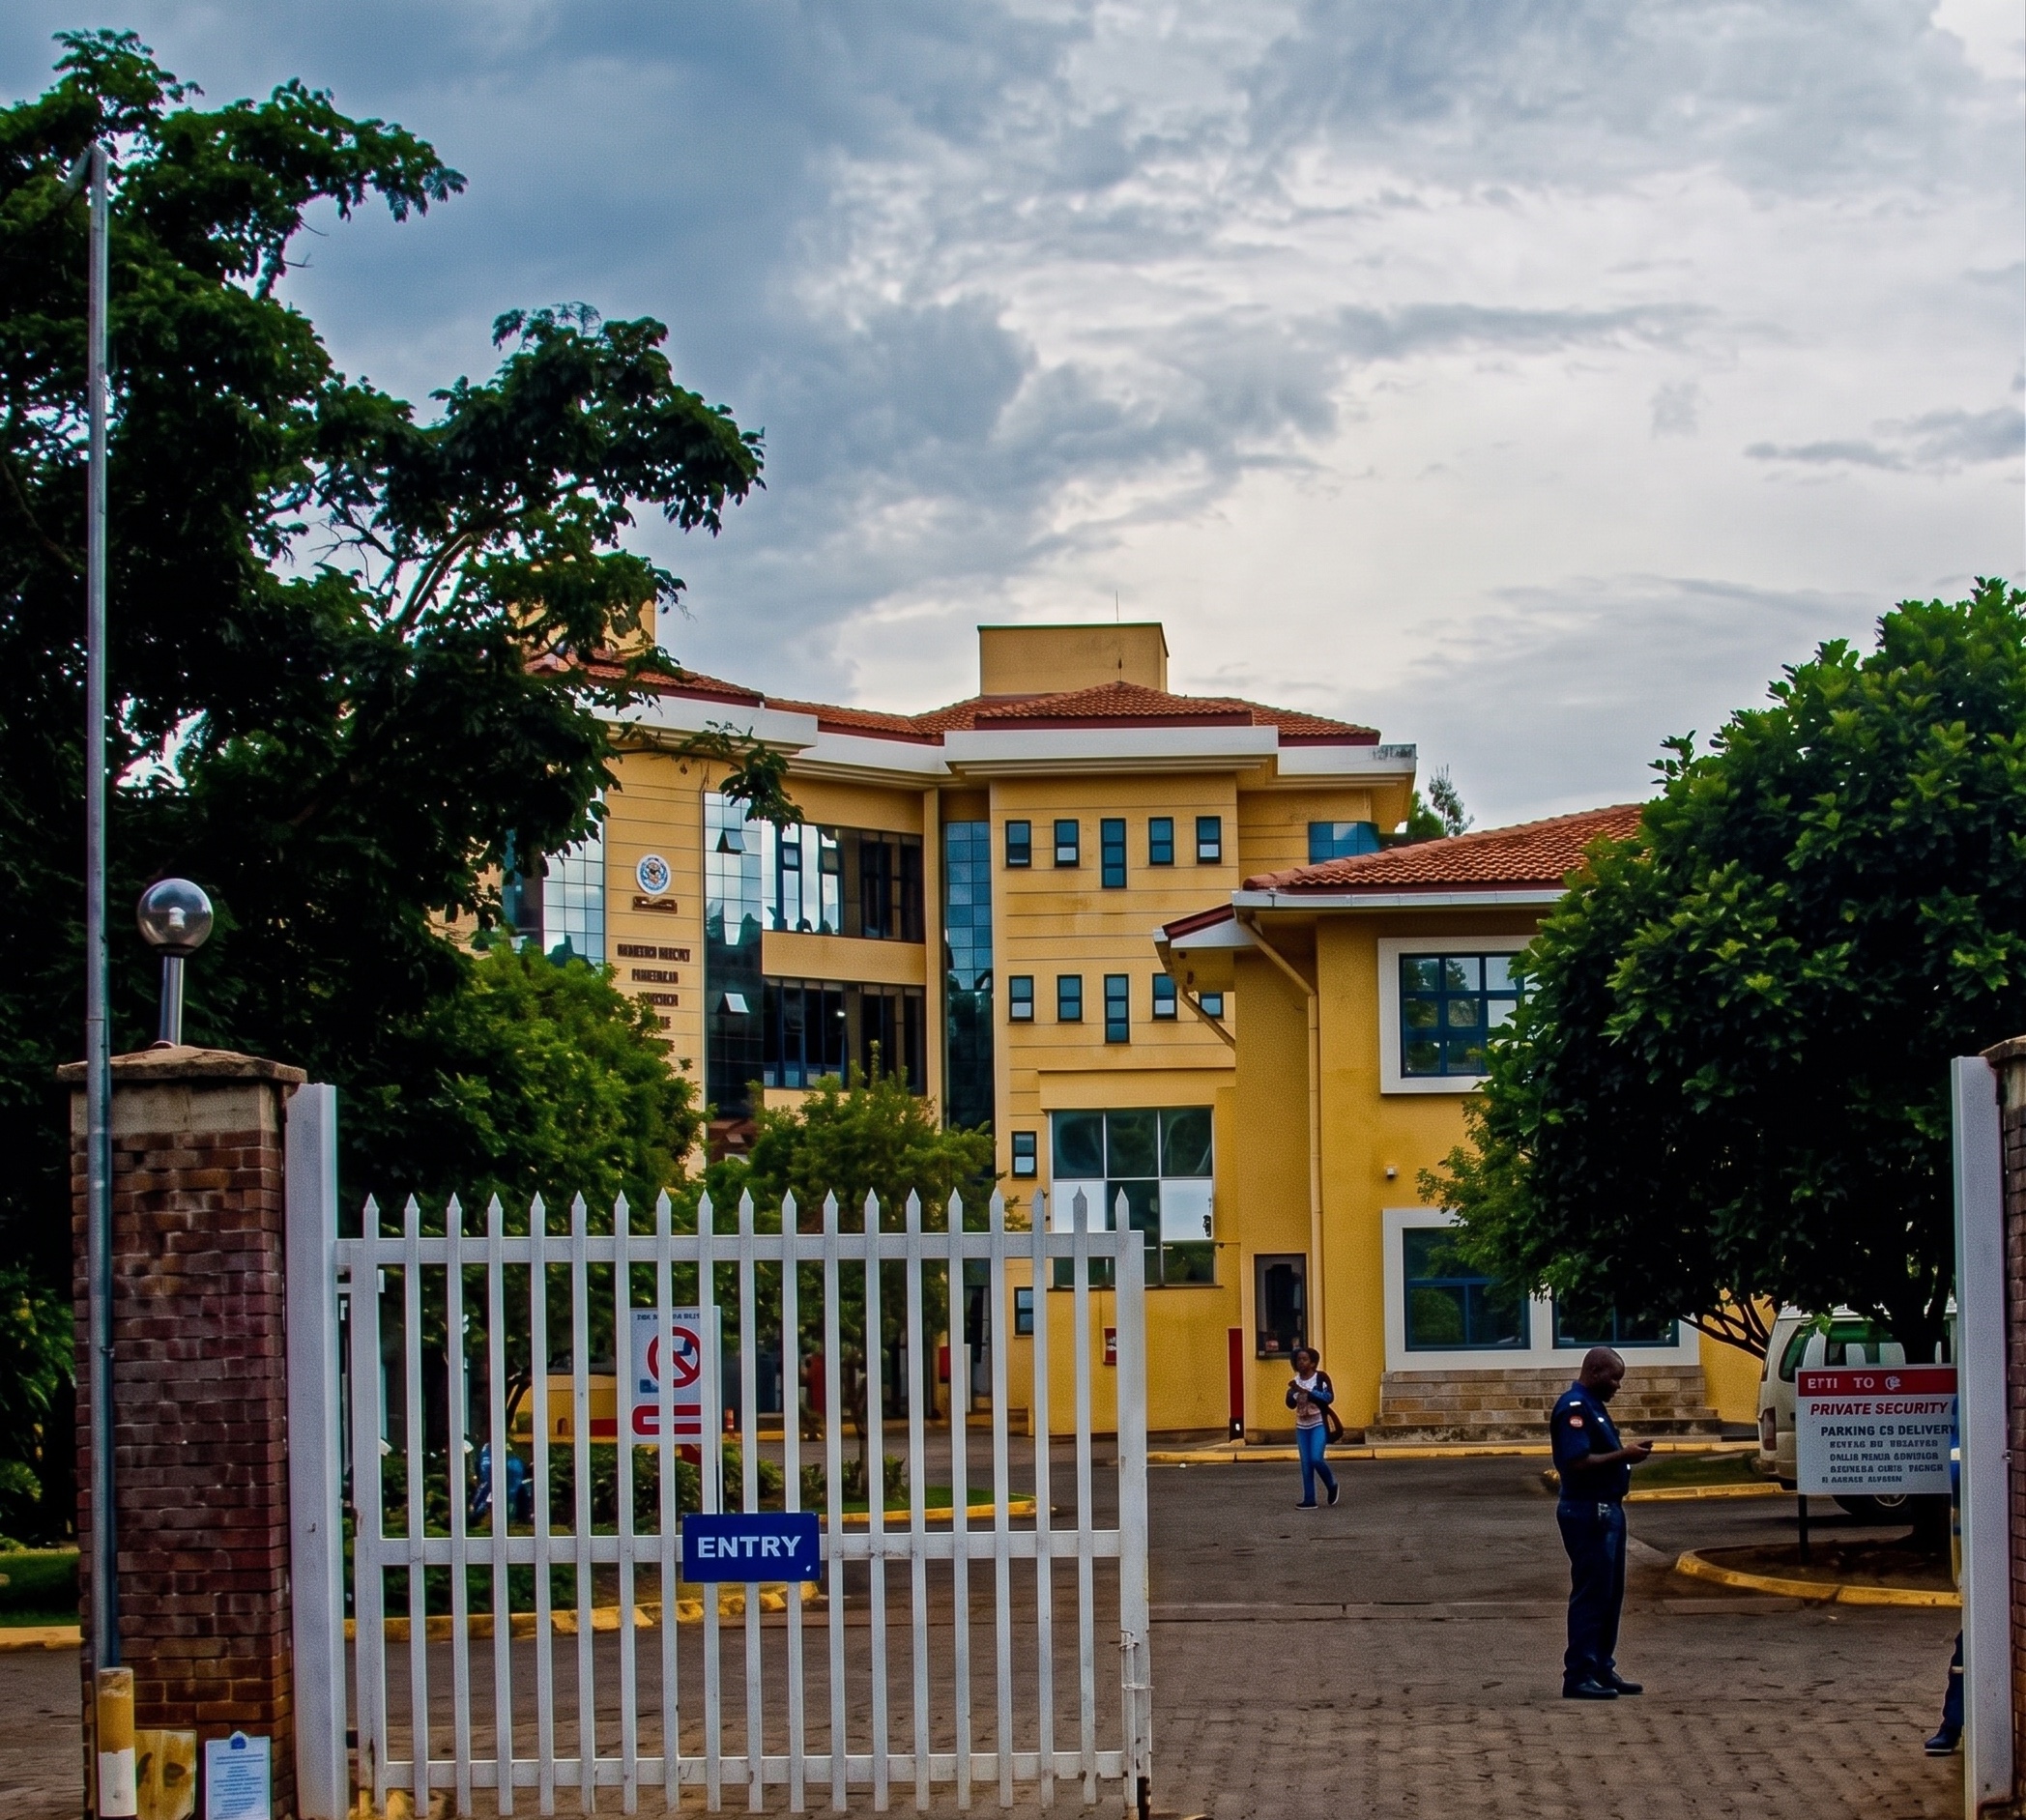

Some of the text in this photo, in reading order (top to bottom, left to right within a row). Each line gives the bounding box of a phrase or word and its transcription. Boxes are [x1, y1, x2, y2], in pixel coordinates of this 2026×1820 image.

[1810, 1401, 1949, 1415] PRIVATE SECURITY
[1821, 1426, 1875, 1436] PARKING
[698, 1536, 801, 1558] ENTRY
